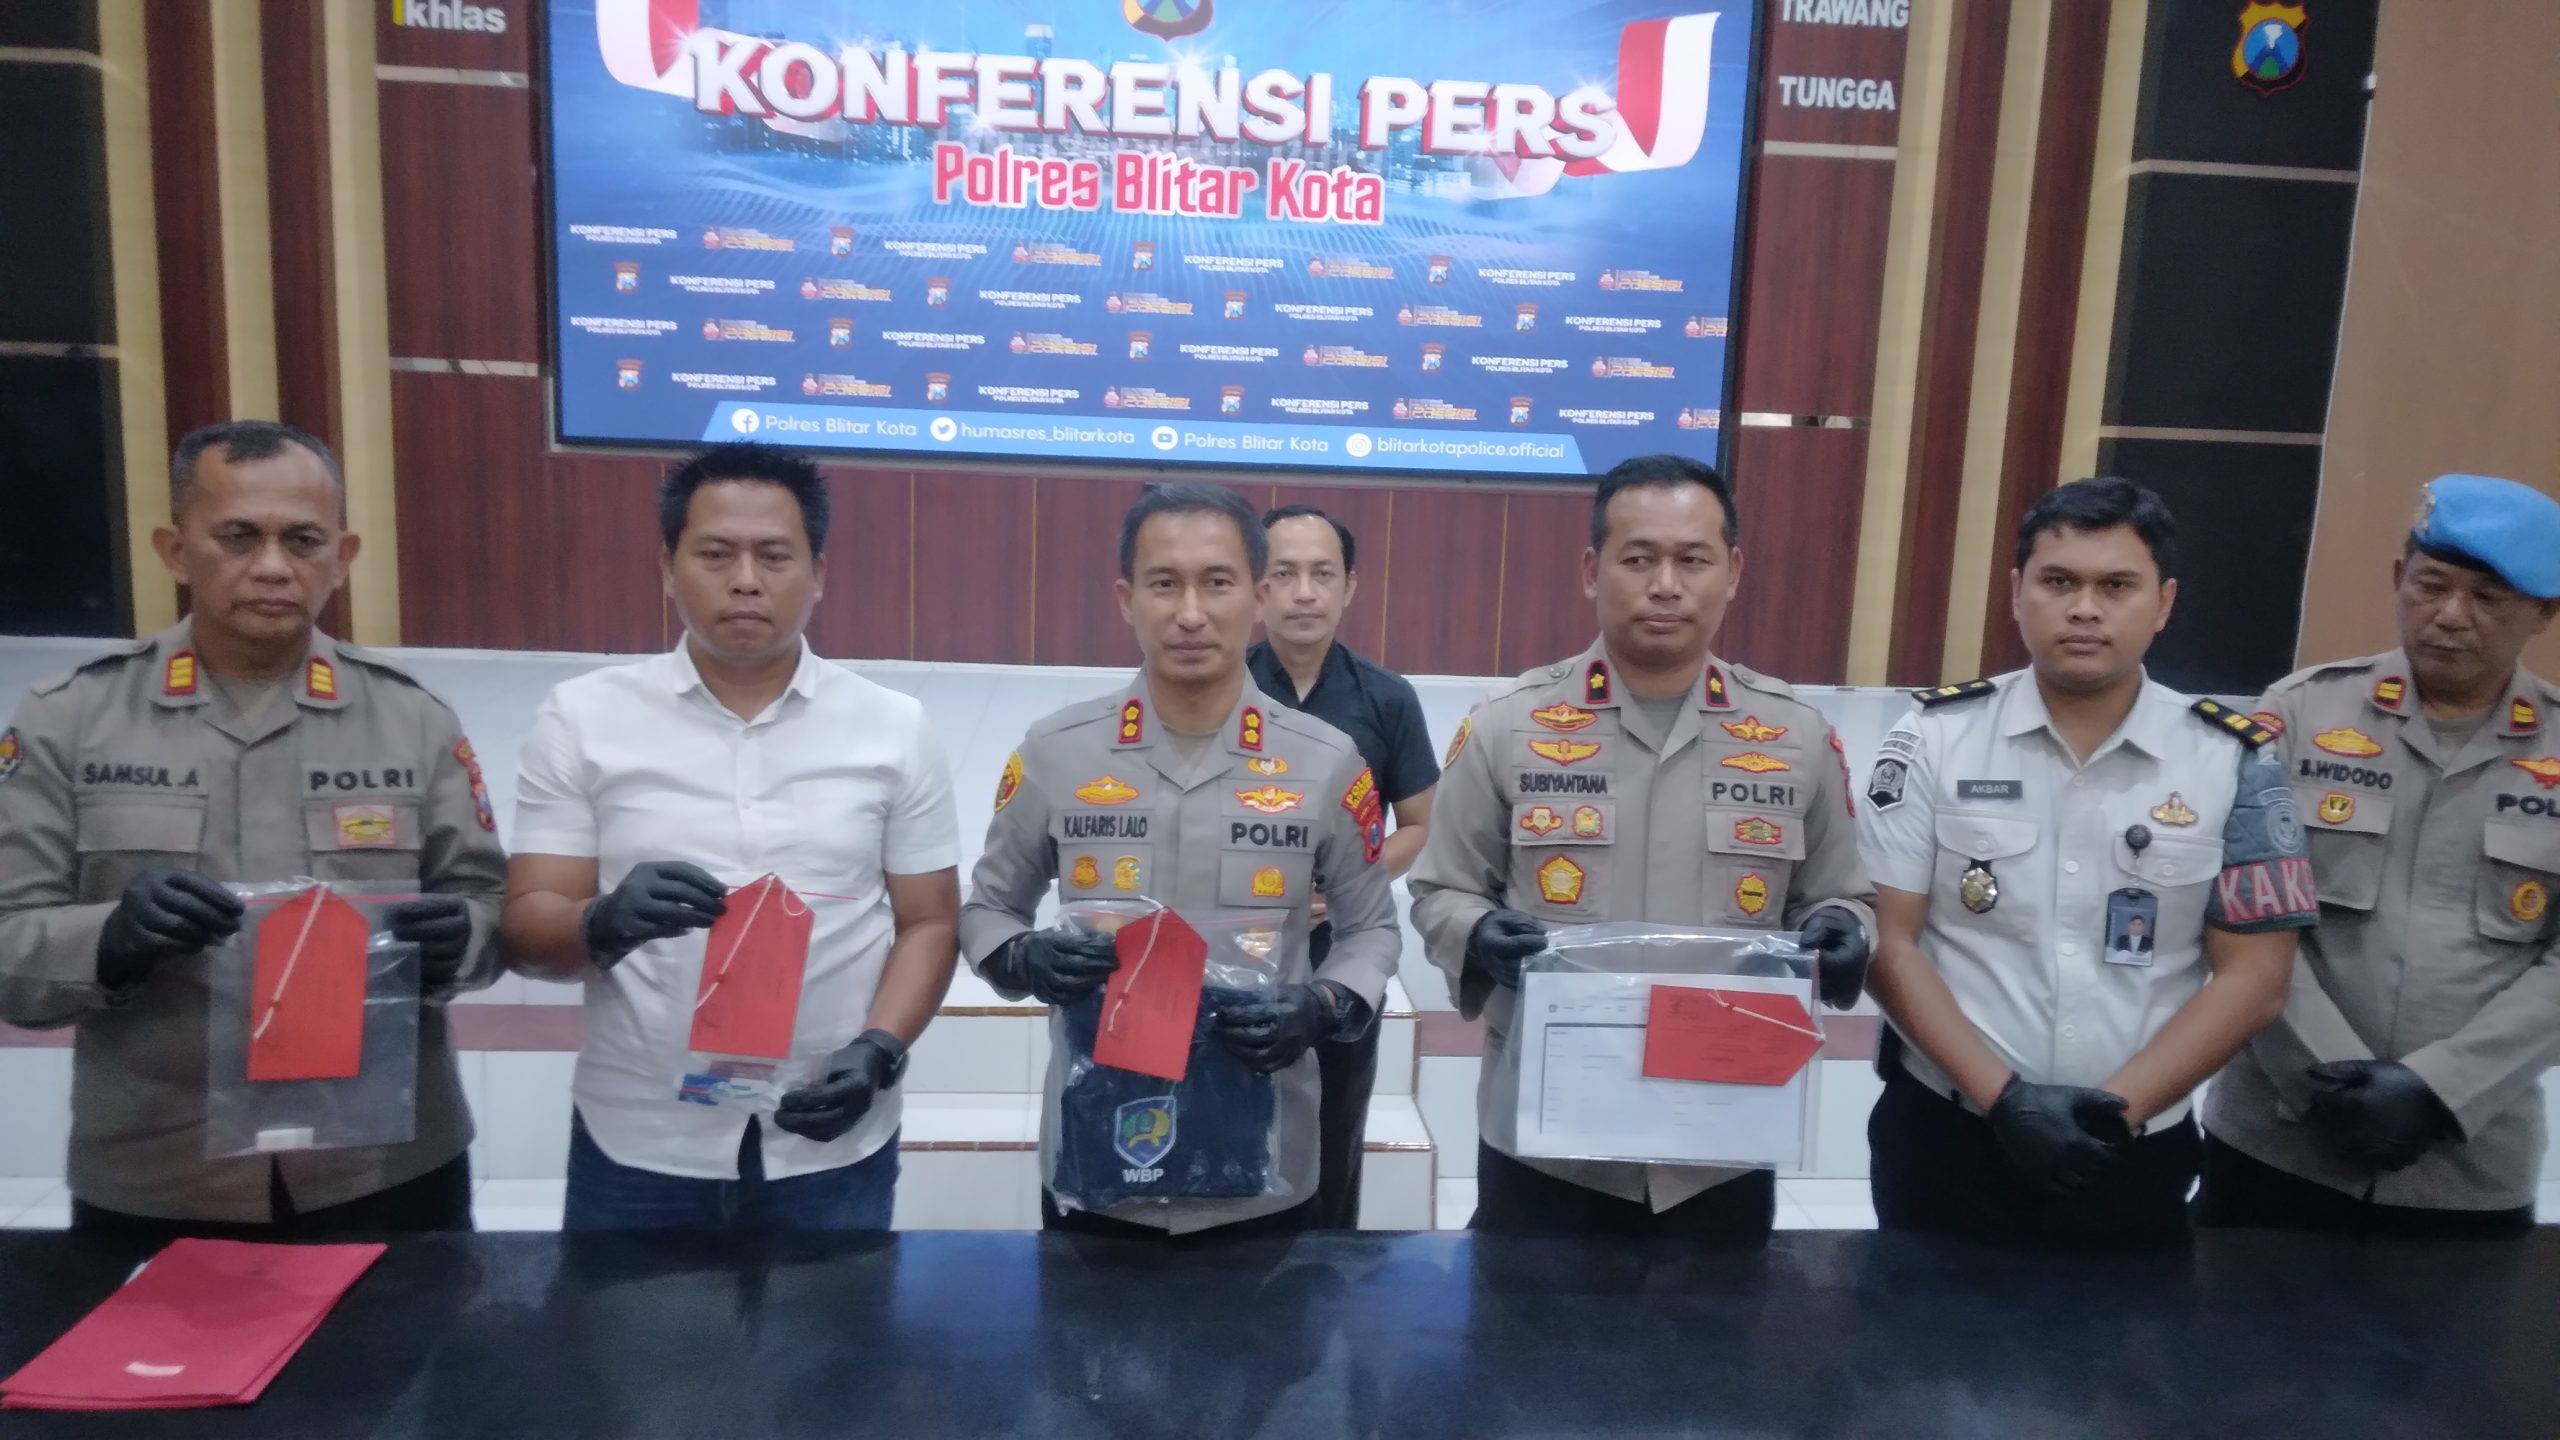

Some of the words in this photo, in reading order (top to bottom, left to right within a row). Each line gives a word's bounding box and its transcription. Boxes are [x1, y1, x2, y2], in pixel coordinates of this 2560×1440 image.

[392, 0, 507, 34] Ikhlas
[690, 38, 1332, 147] KONFERENSI
[1358, 75, 1618, 161] PERS
[1778, 75, 1896, 111] TUNGGA
[935, 143, 1101, 210] Polres
[1115, 152, 1256, 217] Blitar
[1269, 158, 1384, 222] Kota
[884, 240, 956, 252] KONFERENSI
[958, 243, 987, 254] PERS
[1184, 254, 1254, 266] KONFERENSI
[1255, 258, 1283, 268] PERS
[1478, 268, 1546, 279] KONFERENSI
[1547, 271, 1575, 280] PERS
[978, 290, 1050, 302] KONFERENSI
[1051, 293, 1080, 303] PERS
[1274, 303, 1344, 315] KONFERENSI
[1345, 306, 1373, 316] PERS
[1565, 315, 1632, 327] KONFERENSI
[1634, 318, 1661, 328] PERS
[882, 330, 954, 342] KONFERENSI
[955, 333, 984, 344] PERS
[1180, 344, 1249, 355] KONFERENSI
[1250, 347, 1278, 357] PERS
[1472, 355, 1539, 367] KONFERENSI
[1540, 359, 1568, 368] PERS
[978, 385, 1049, 397] KONFERENSI
[1050, 388, 1078, 398] PERS
[1271, 397, 1339, 409] KONFERENSI
[1340, 400, 1368, 410] PERS
[1559, 408, 1626, 420] KONFERENSI
[1627, 411, 1654, 421] PERS
[765, 414, 821, 433] Polres
[826, 417, 871, 435] Blitar
[877, 420, 917, 437] Kota
[961, 422, 1135, 445] humasres_blitarkota
[1184, 432, 1237, 450] Polres
[1242, 435, 1284, 451] Blitar
[1290, 437, 1329, 453] Kota
[1377, 437, 1565, 459] blitarkotapolice.official
[310, 769, 415, 791] POLRI
[1519, 772, 1609, 794] SUBIYANTANA
[1712, 782, 1795, 806] POLRI
[1970, 784, 2009, 794] AKBAR
[1063, 815, 1117, 838] KALFARIS
[1118, 815, 1148, 838] LALO
[1231, 822, 1309, 848] POLRI
[1122, 1168, 1165, 1183] WBP
